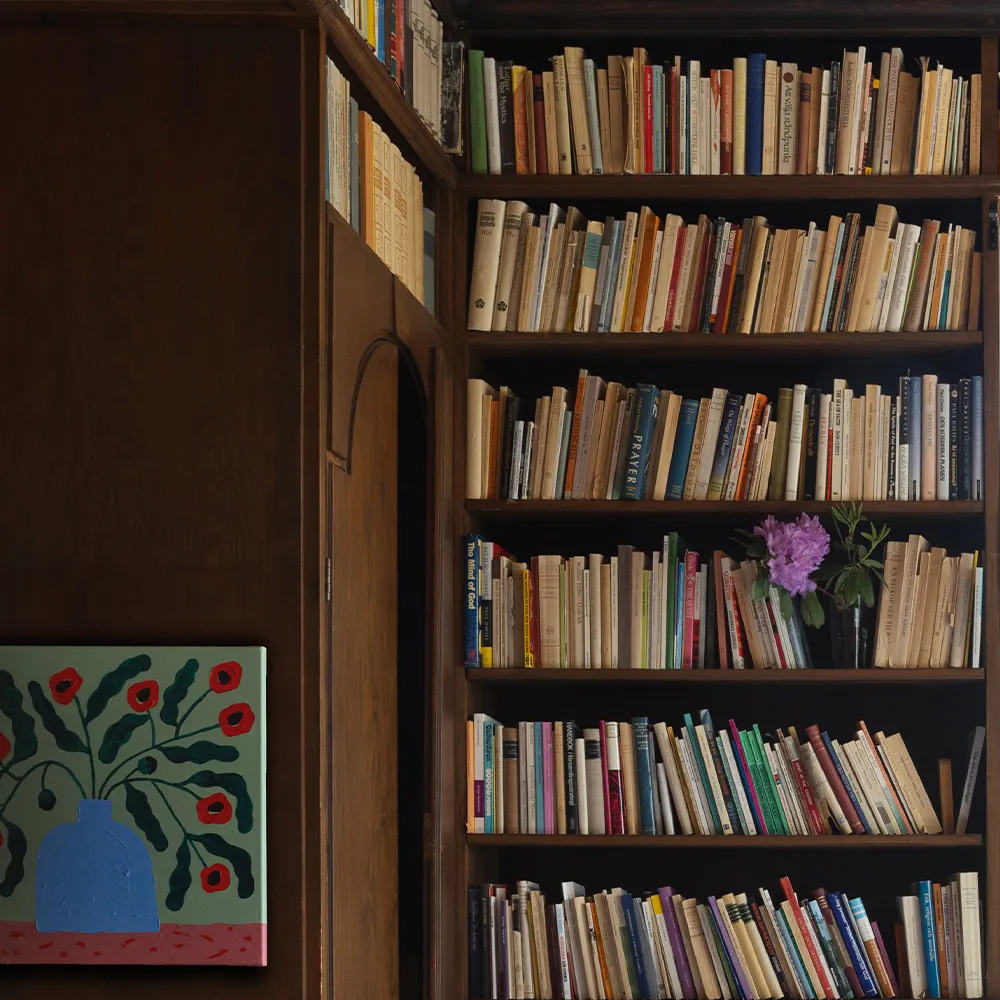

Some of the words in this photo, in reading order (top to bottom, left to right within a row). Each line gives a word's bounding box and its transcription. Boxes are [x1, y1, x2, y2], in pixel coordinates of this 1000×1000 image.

[498, 65, 506, 79] and
[498, 81, 507, 93] the
[784, 84, 792, 96] Att
[499, 95, 508, 123] Mystics
[782, 97, 792, 115] välja
[780, 116, 792, 164] ståndpunkt
[626, 434, 642, 483] PRAYER
[467, 542, 475, 556] The
[467, 559, 476, 579] Mind
[467, 581, 476, 590] of
[888, 578, 897, 604] BISKOP
[467, 592, 476, 609] God
[886, 604, 894, 619] SER
[922, 892, 930, 904] Etik,
[923, 906, 932, 926] religion
[927, 939, 935, 961] samhälle
